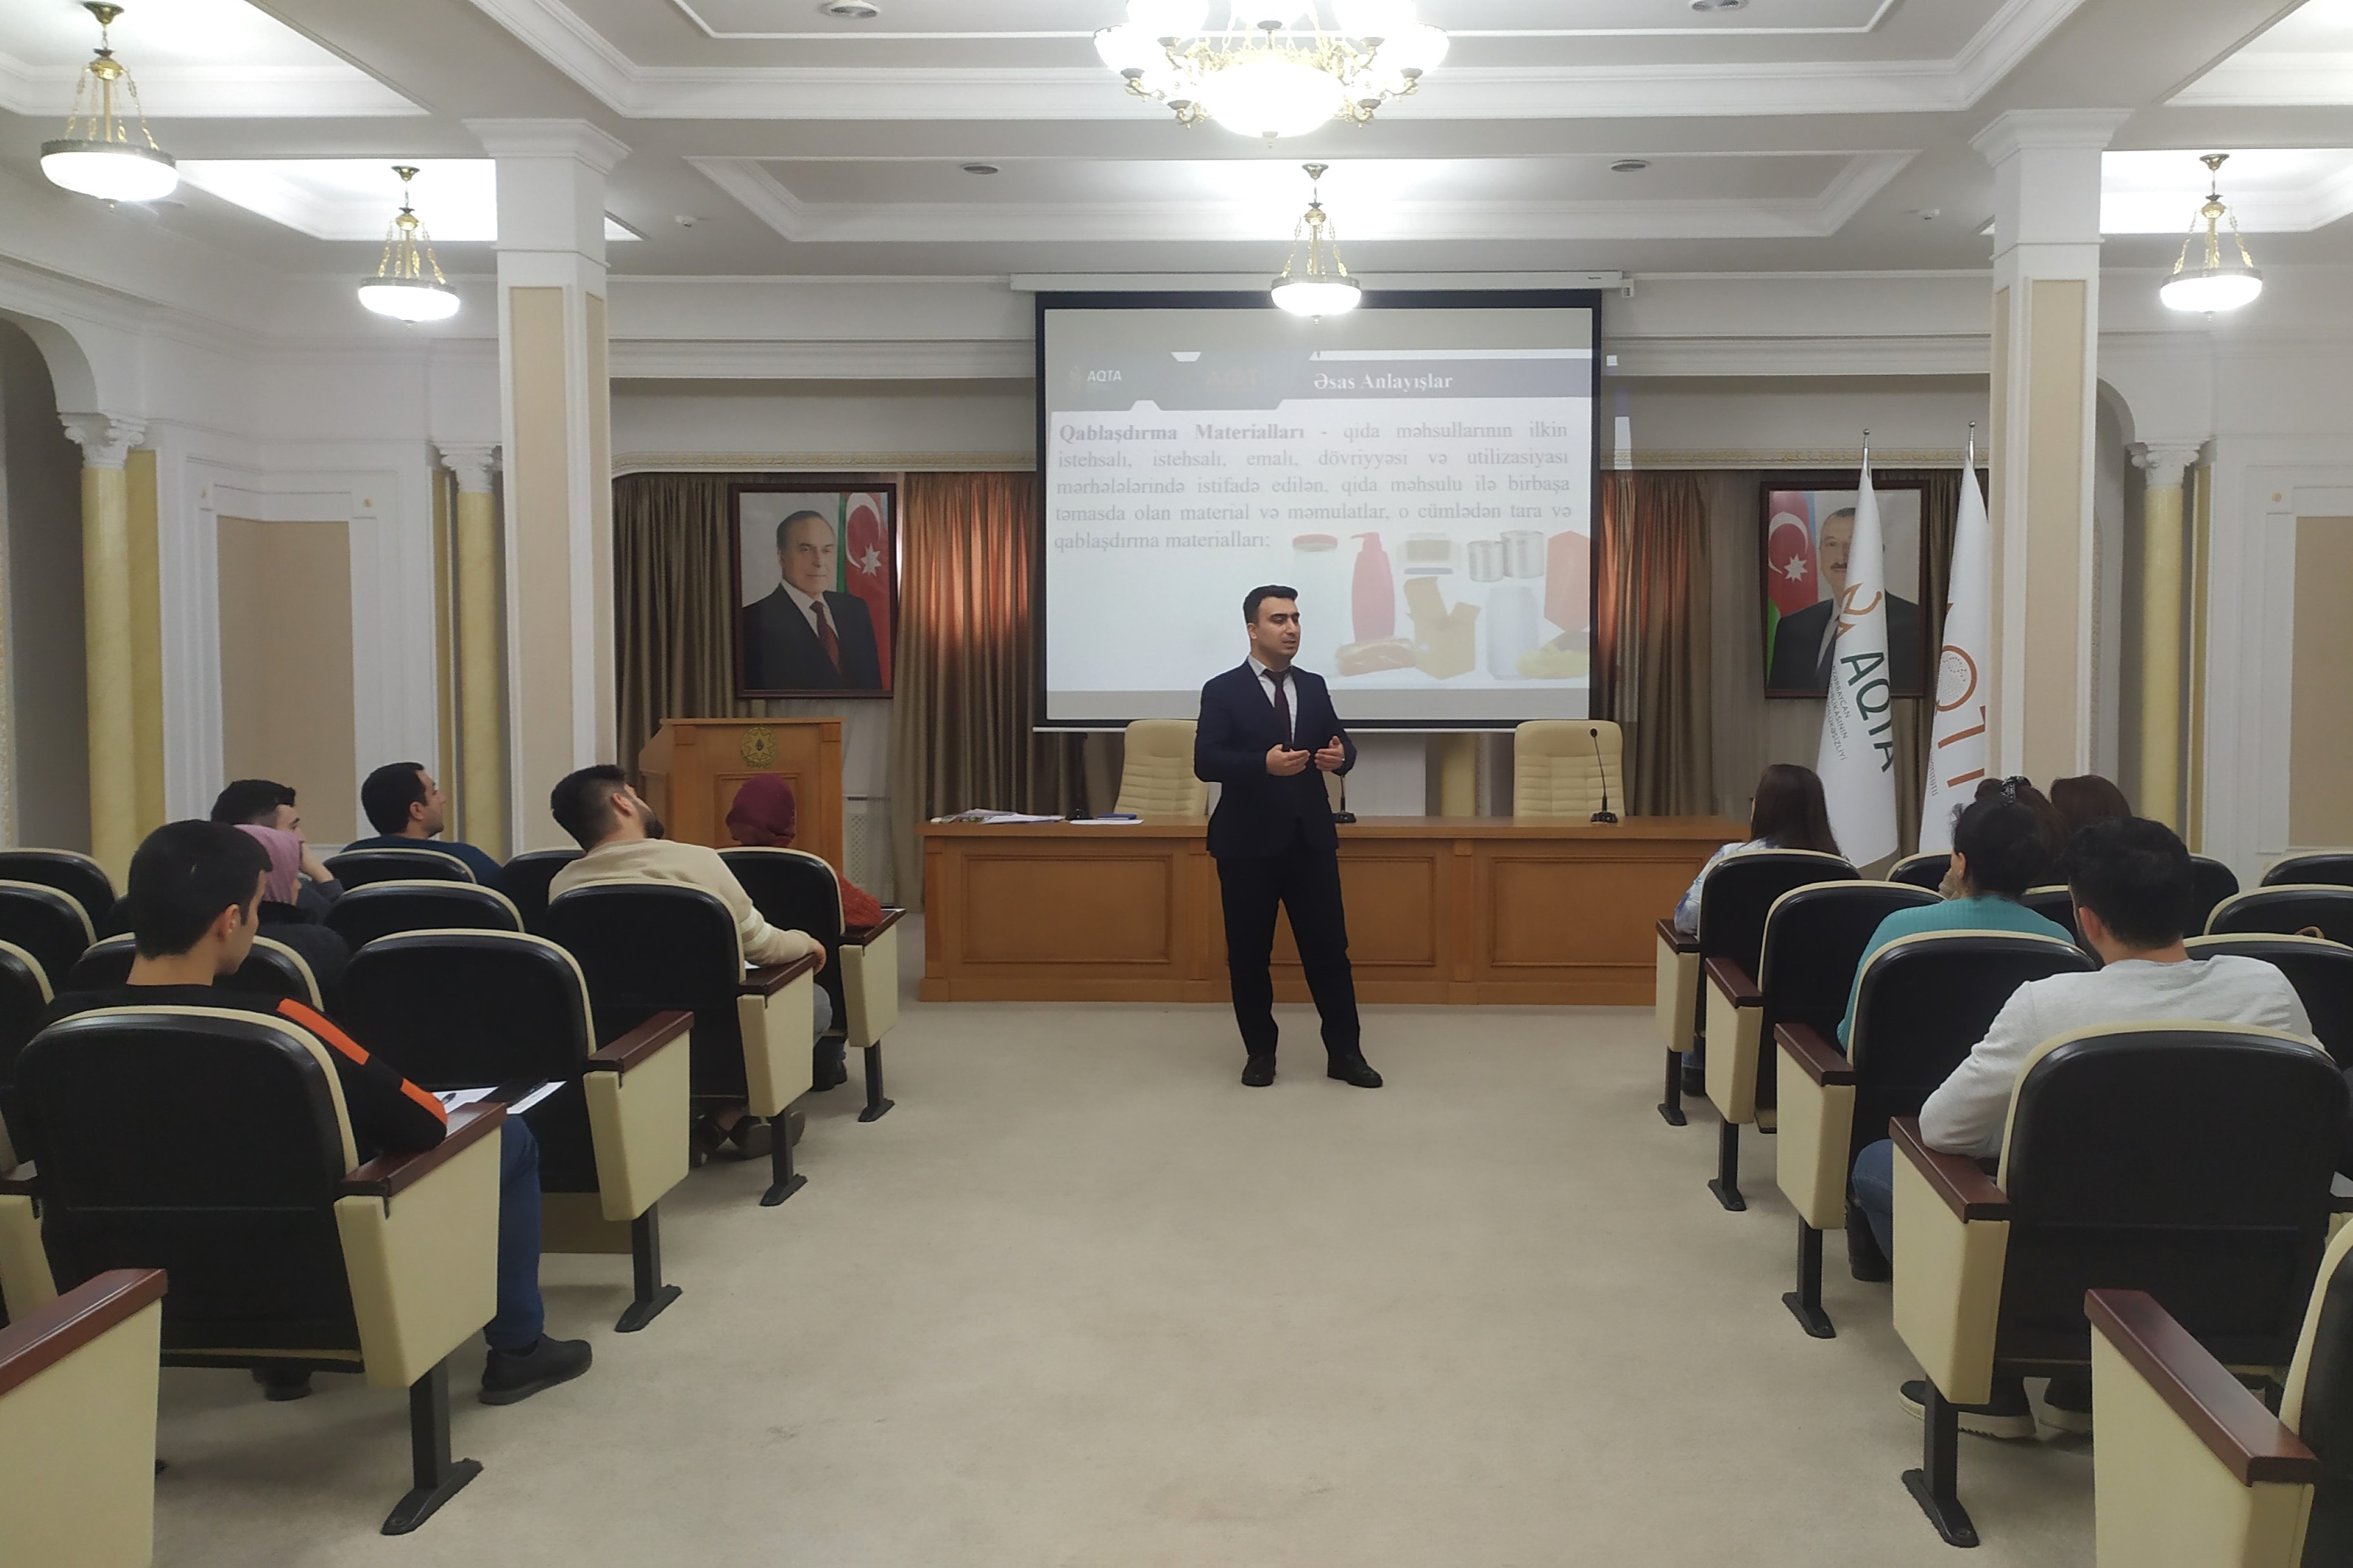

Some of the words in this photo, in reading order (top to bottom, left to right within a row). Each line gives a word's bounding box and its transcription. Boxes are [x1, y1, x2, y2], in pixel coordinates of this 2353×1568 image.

[1087, 369, 1122, 383] AQTA
[1313, 373, 1356, 389] Əsas
[1361, 373, 1453, 393] Anlayışlar
[1059, 424, 1177, 443] Qablaşdırma
[1195, 424, 1305, 440] Materialları
[1344, 422, 1380, 442] qida
[1396, 421, 1513, 438] məhsullarının
[1529, 421, 1568, 438] ilkin
[1058, 451, 1132, 468] istehsalı,
[1153, 449, 1227, 468] istehsalı,
[1246, 449, 1298, 467] emalı,
[1318, 449, 1408, 468] dövriyyəsi
[1427, 453, 1448, 465] və
[1467, 447, 1568, 468] utilizasiyası
[1056, 477, 1185, 494] mərhələlərində
[1197, 476, 1260, 493] istifadə
[1271, 476, 1329, 494] edilən,
[1341, 475, 1378, 495] qida
[1390, 475, 1462, 491] məhsulu
[1476, 474, 1497, 491] ilə
[1508, 474, 1570, 495] birbaşa
[1055, 505, 1126, 521] təmasda
[1134, 504, 1172, 521] olan
[1180, 503, 1250, 521] material
[1259, 507, 1280, 520] və
[1287, 502, 1390, 521] məmulatlar,
[1398, 507, 1409, 518] o
[1418, 501, 1501, 518] cümlədən
[1510, 504, 1543, 518] tara
[1551, 507, 1572, 518] və
[1054, 531, 1160, 551] qablaşdırma
